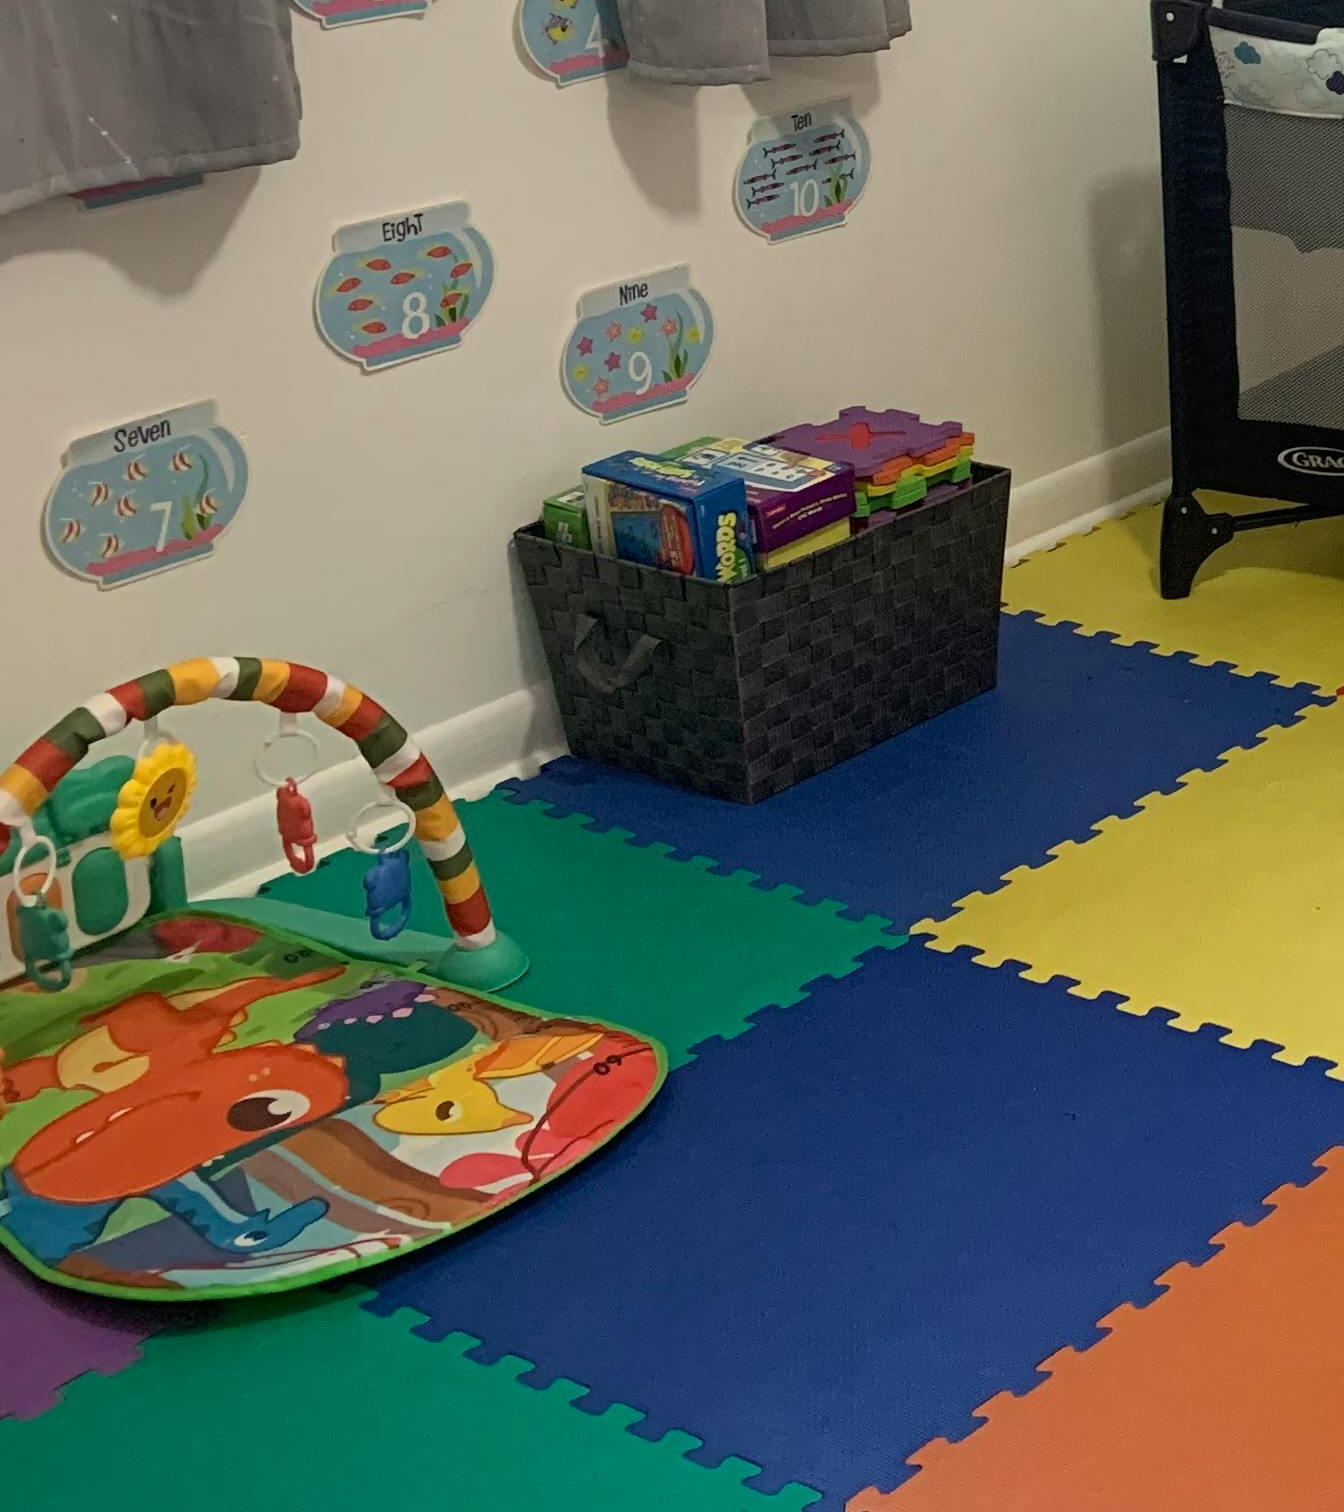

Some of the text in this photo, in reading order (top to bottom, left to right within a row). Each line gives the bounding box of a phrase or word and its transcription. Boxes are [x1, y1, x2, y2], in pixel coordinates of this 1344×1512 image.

[791, 112, 812, 132] Ten
[790, 178, 820, 217] 10
[619, 282, 648, 306] Nine
[402, 292, 431, 339] 8
[628, 351, 652, 396] 9
[113, 419, 172, 453] Seven
[150, 500, 173, 553] 7
[716, 512, 738, 584] WORDS
